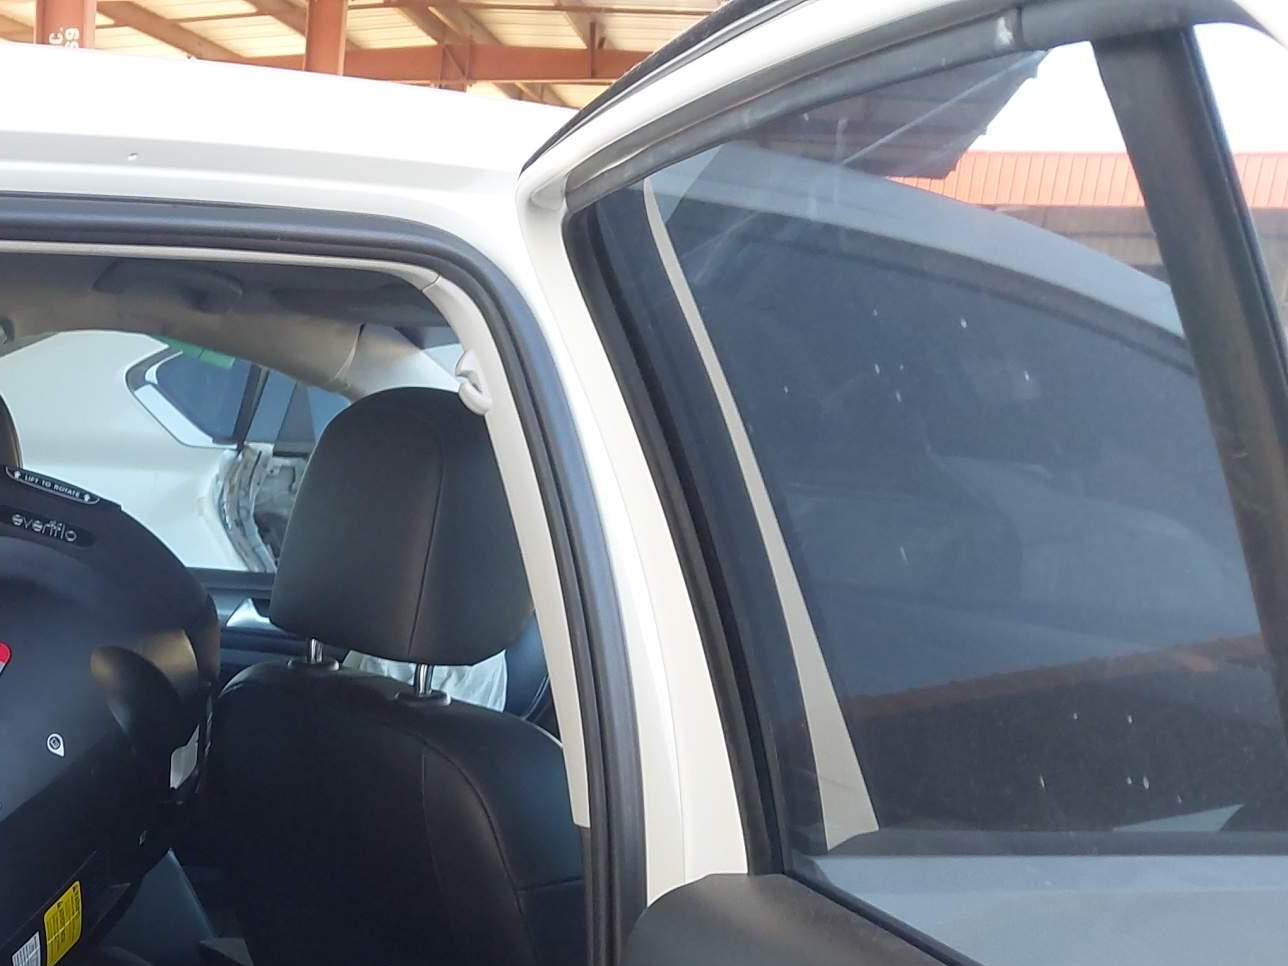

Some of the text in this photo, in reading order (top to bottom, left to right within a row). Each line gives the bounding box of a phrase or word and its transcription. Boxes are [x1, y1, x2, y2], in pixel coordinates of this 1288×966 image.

[24, 474, 81, 498] LIFT TO ROTATE
[12, 513, 77, 542] evenflo
